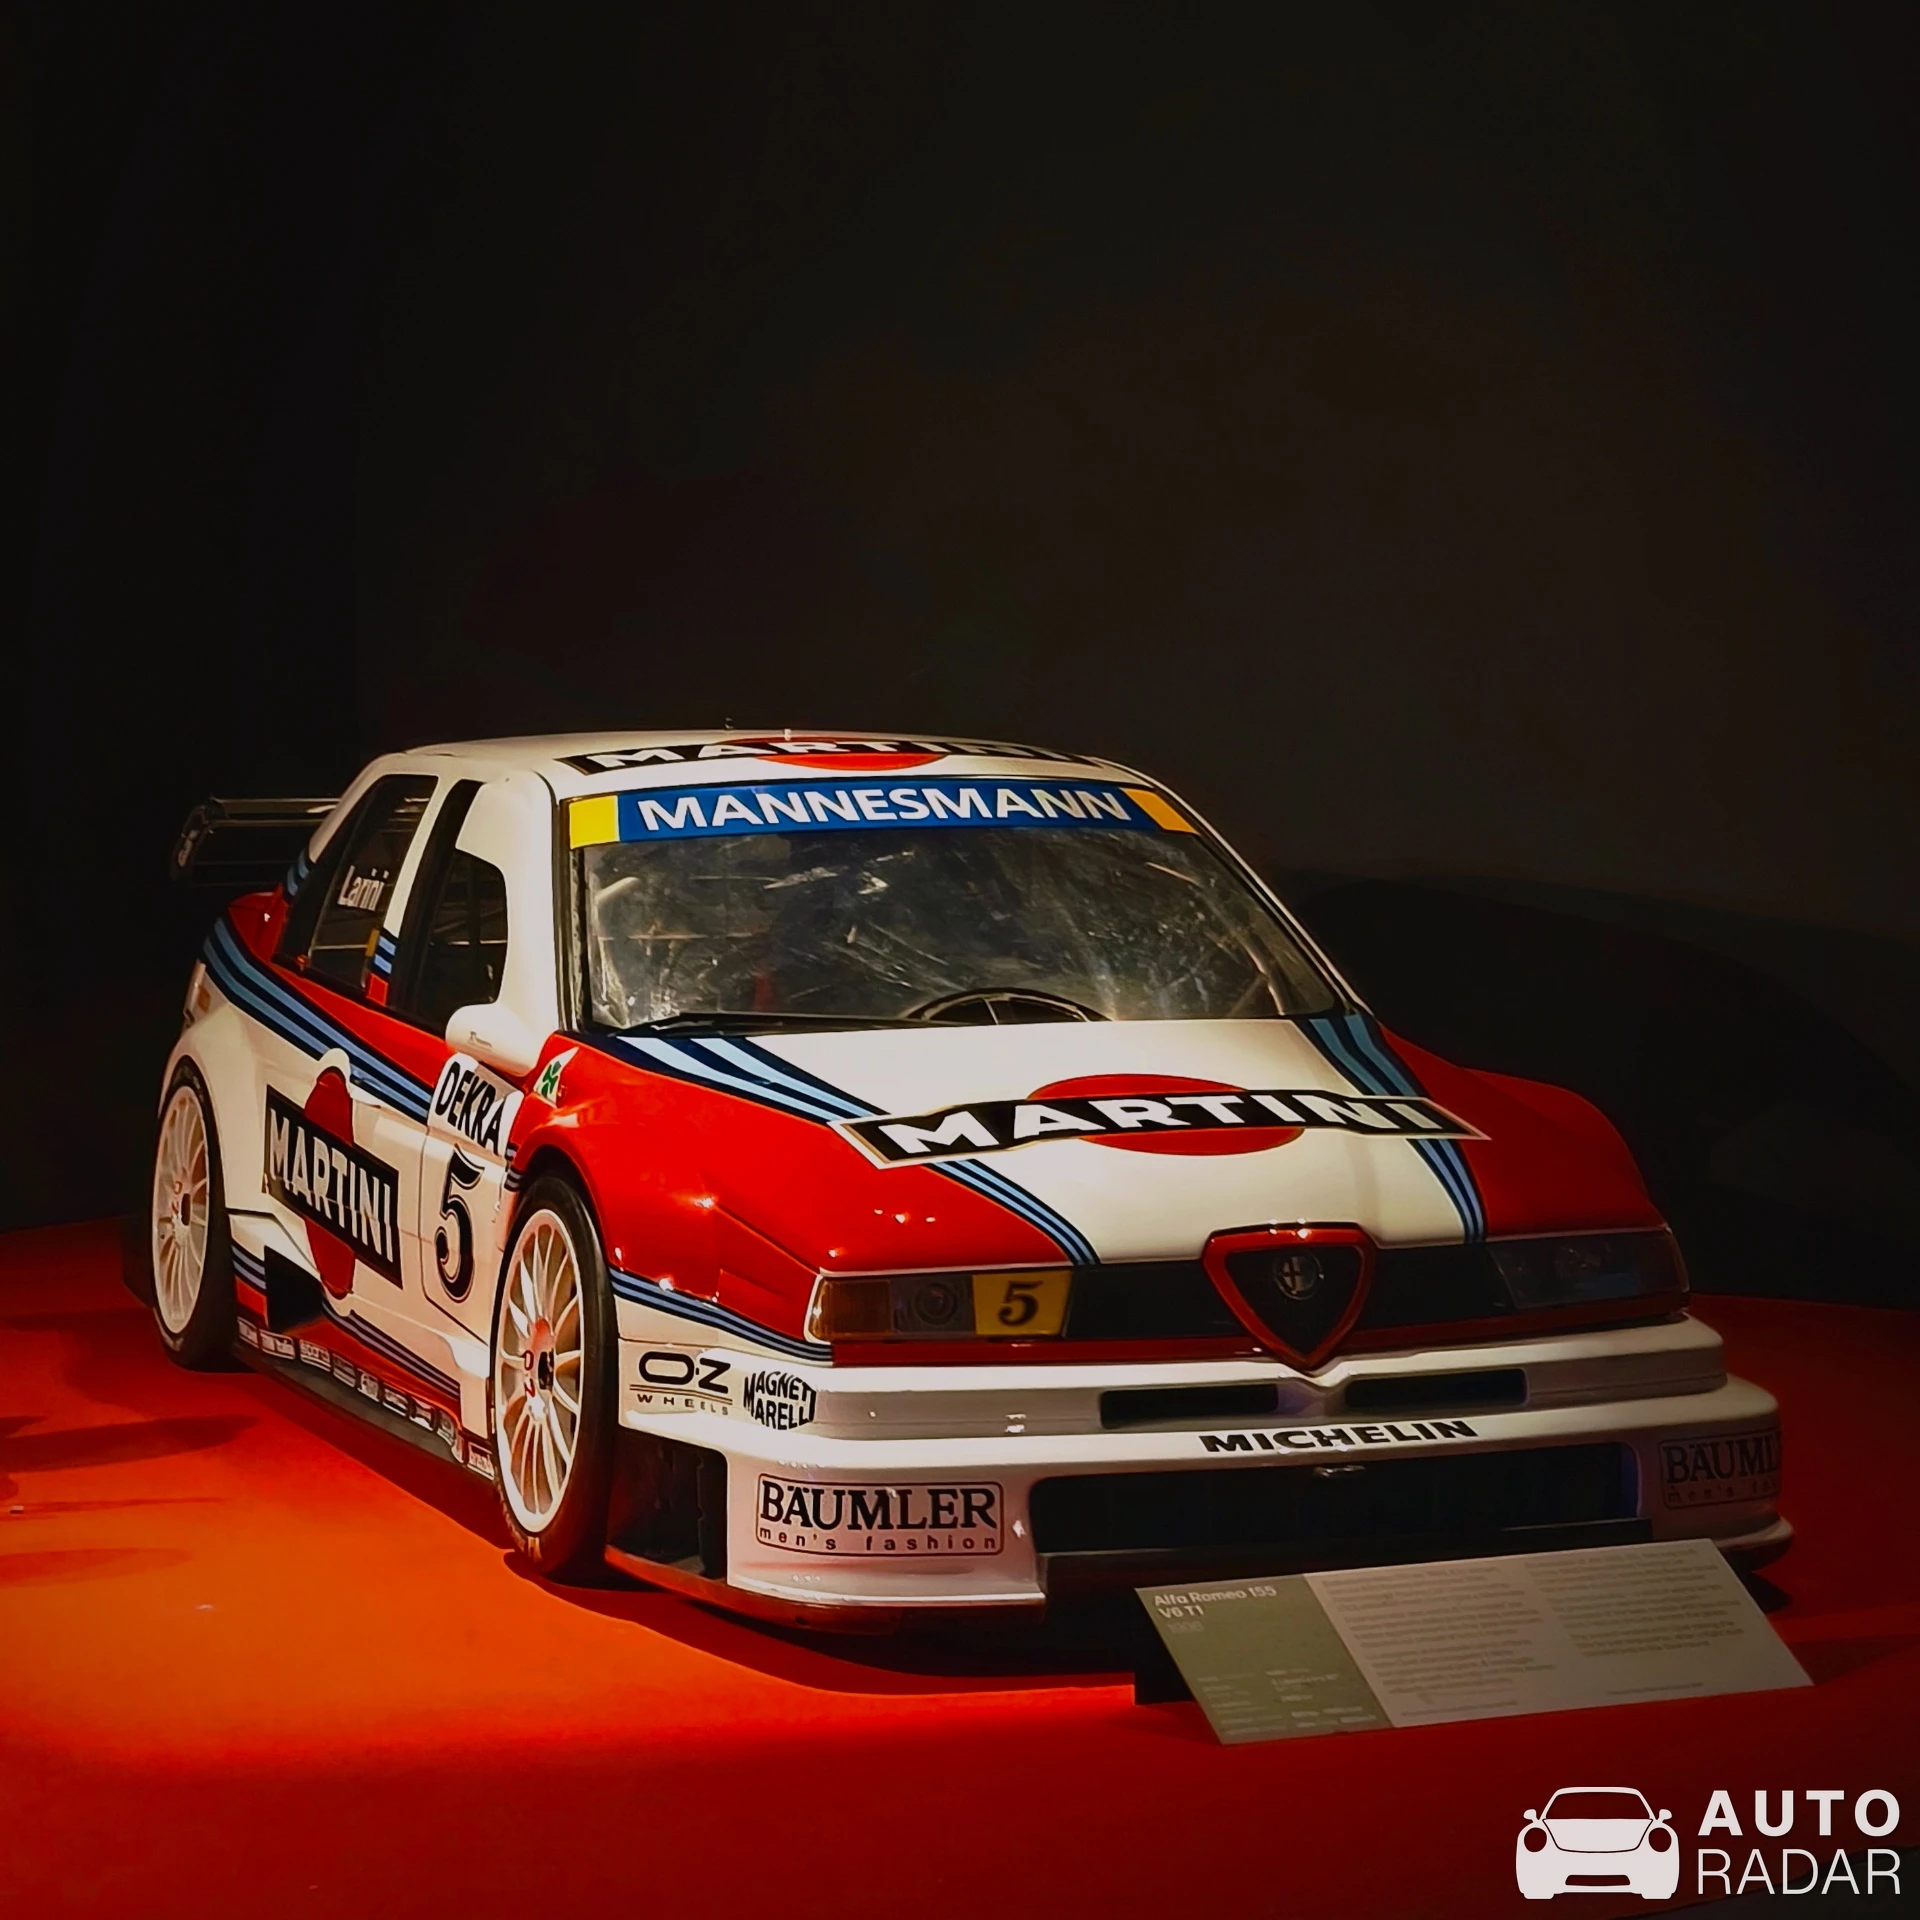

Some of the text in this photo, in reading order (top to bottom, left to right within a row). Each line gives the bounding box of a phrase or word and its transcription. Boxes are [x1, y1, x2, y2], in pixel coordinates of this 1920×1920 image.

[586, 743, 1072, 773] MARTINI
[637, 787, 1132, 832] MANNESMANN
[437, 1061, 506, 1154] DEKRA
[886, 1093, 1430, 1154] MARTINI
[268, 1109, 395, 1262] MARTINI
[434, 1145, 483, 1304] 5
[997, 1281, 1044, 1327] 5
[637, 1394, 730, 1416] WHEELS
[1199, 1419, 1478, 1453] MICHELIN
[1662, 1431, 1781, 1484] BÄUML
[759, 1482, 996, 1531] BÄUMLER
[758, 1526, 998, 1552] men's fashion
[1154, 1586, 1278, 1606] Alfa Romeo 155
